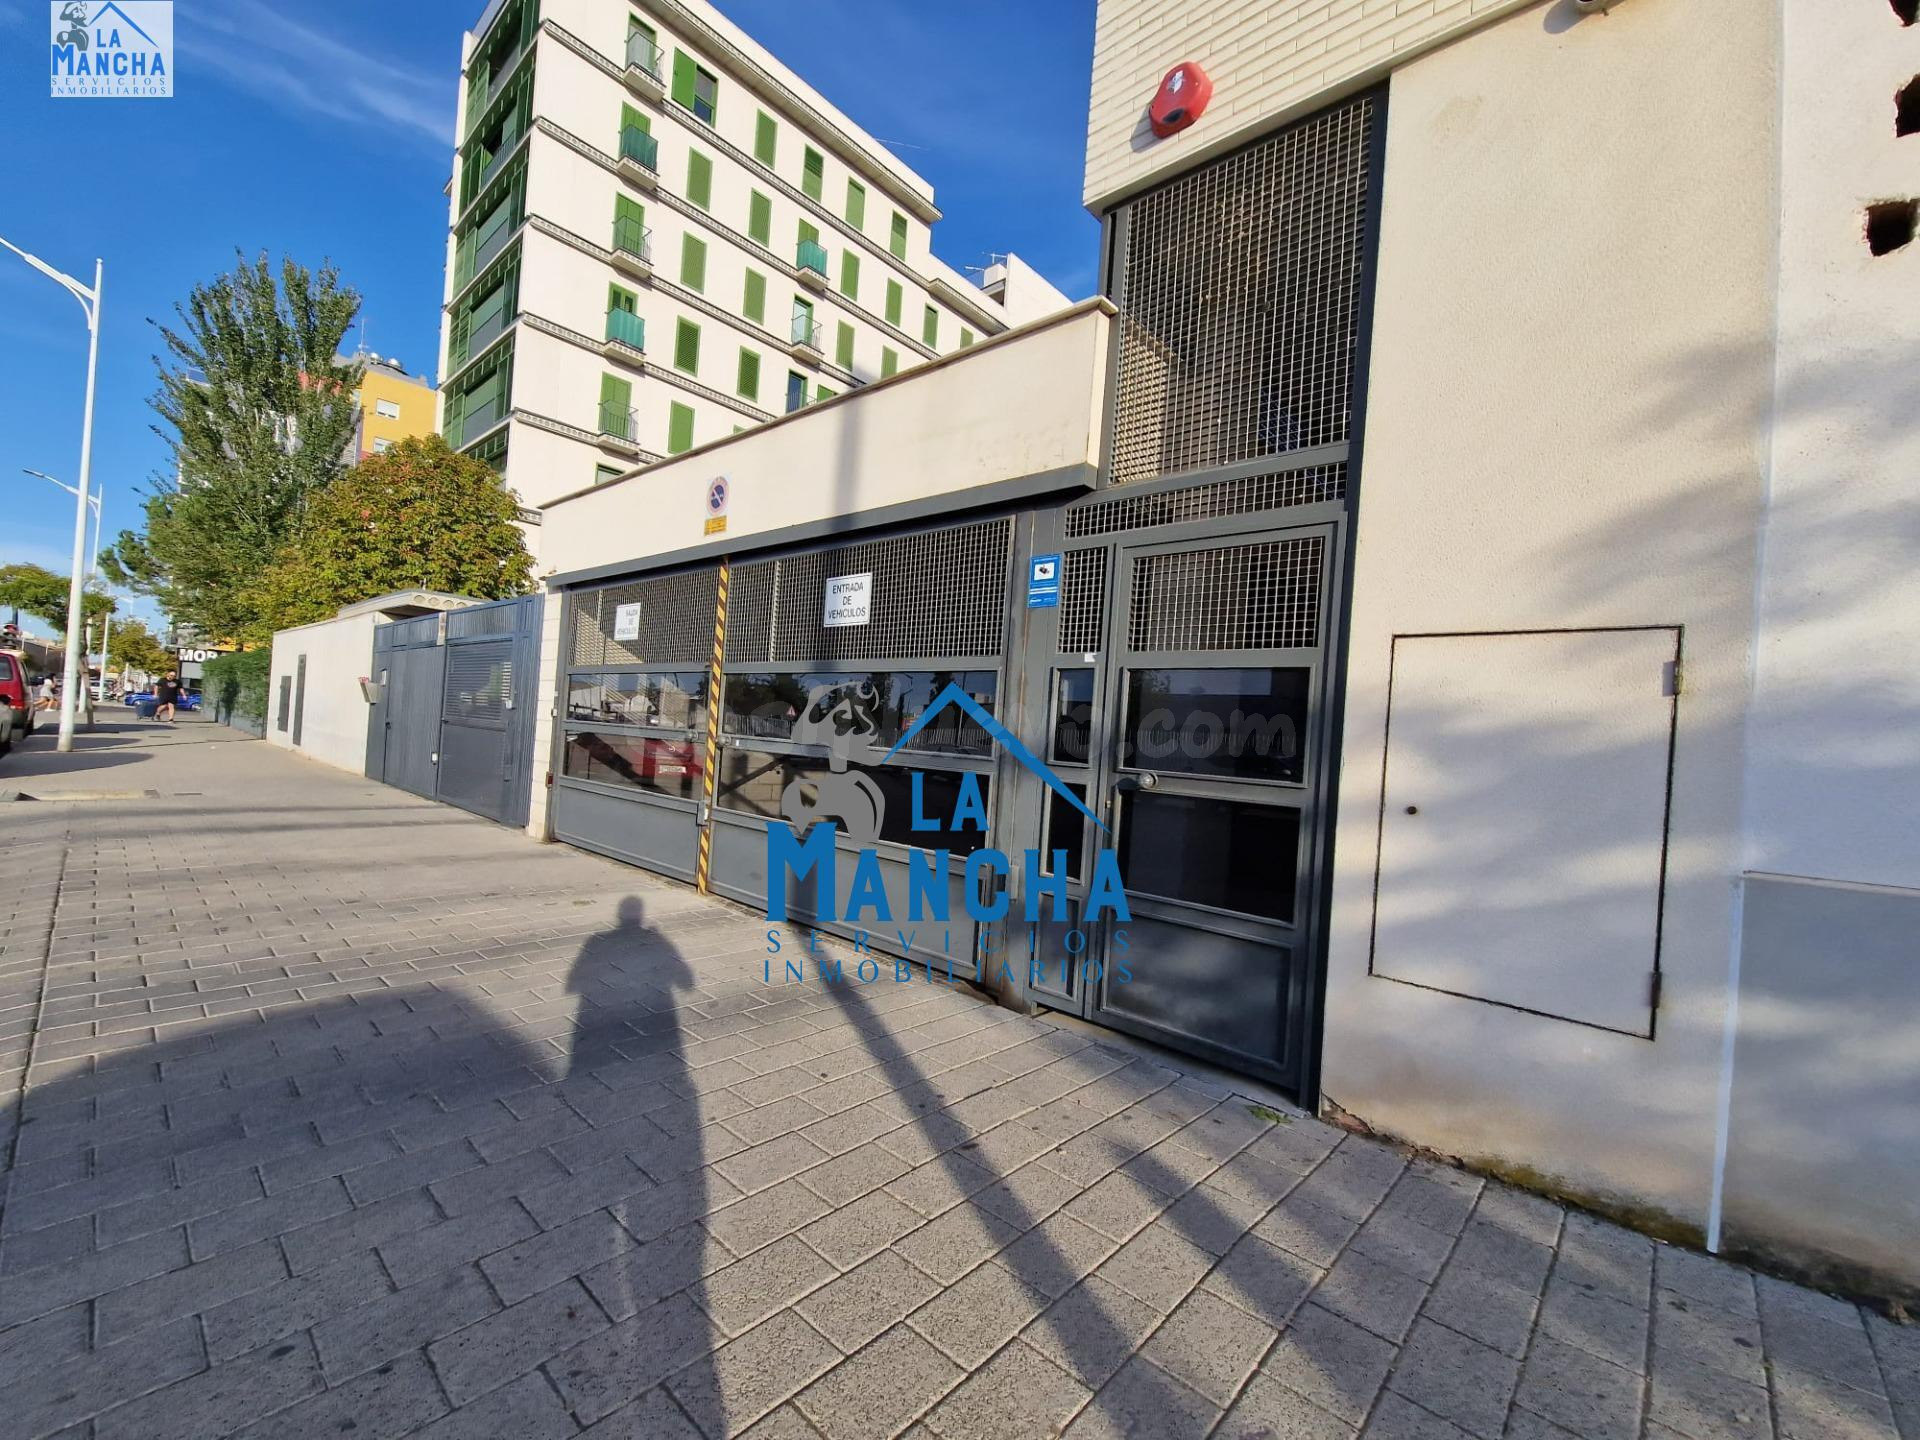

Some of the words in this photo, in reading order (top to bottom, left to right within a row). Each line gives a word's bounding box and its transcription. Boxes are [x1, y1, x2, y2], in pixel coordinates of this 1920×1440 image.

[832, 581, 864, 594] ENTRADA
[842, 595, 852, 606] DE
[828, 607, 867, 619] VEHICULOS
[178, 648, 221, 663] MOR
